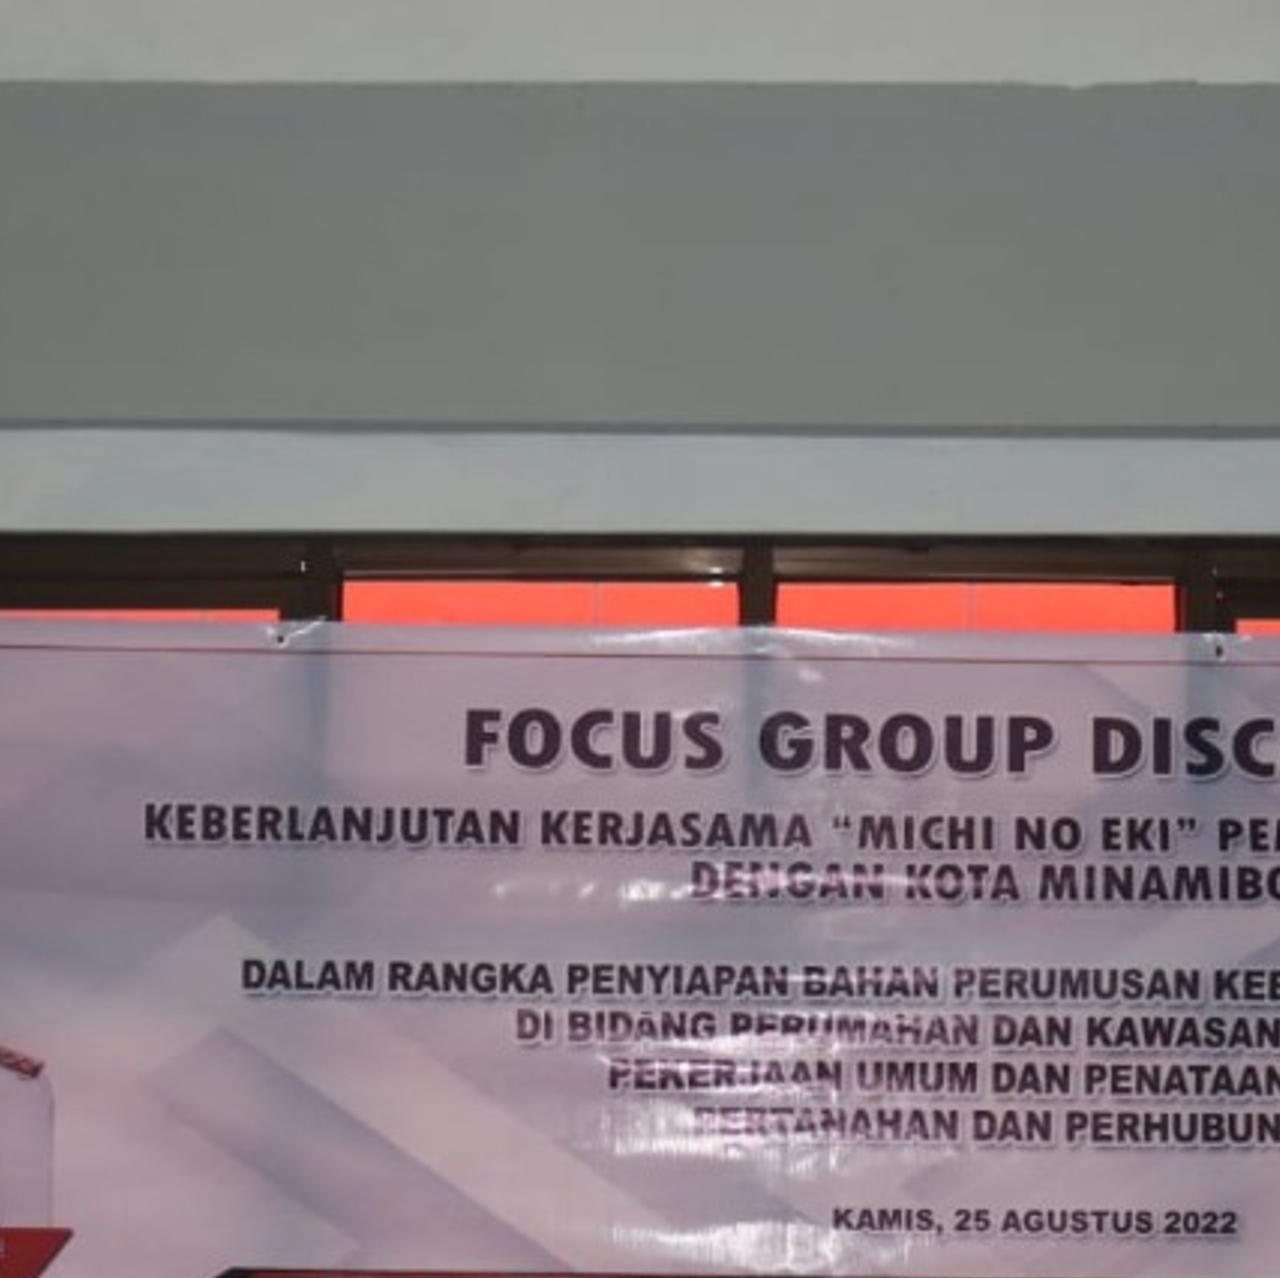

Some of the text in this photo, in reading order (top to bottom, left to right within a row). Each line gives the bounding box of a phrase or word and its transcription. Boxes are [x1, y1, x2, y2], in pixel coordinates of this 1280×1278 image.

[464, 709, 723, 770] FOCUS
[759, 711, 1056, 774] GROUP
[144, 803, 520, 847] KEBERLANJUTAN
[540, 810, 813, 849] KERJASAMA
[1014, 817, 1082, 852] NO
[690, 861, 886, 900] DENGAN
[905, 864, 1021, 901] KOTA
[241, 959, 375, 992] DALAM
[388, 962, 554, 995] RANGKA
[568, 964, 789, 997] PENYIAPAN
[804, 966, 939, 999] BAHAN
[953, 969, 1200, 1002] PERUMUSAN
[517, 1009, 554, 1041] DI
[568, 1010, 716, 1041] BIDANG
[992, 1015, 1071, 1048] DAN
[608, 1059, 842, 1092] PEKERJAAN
[857, 1062, 979, 1094] UMUM
[992, 1063, 1071, 1095] DAN
[973, 1110, 1051, 1142] DAN
[833, 1207, 1238, 1236] KAMIS, 25 AGUSTUS 2022
